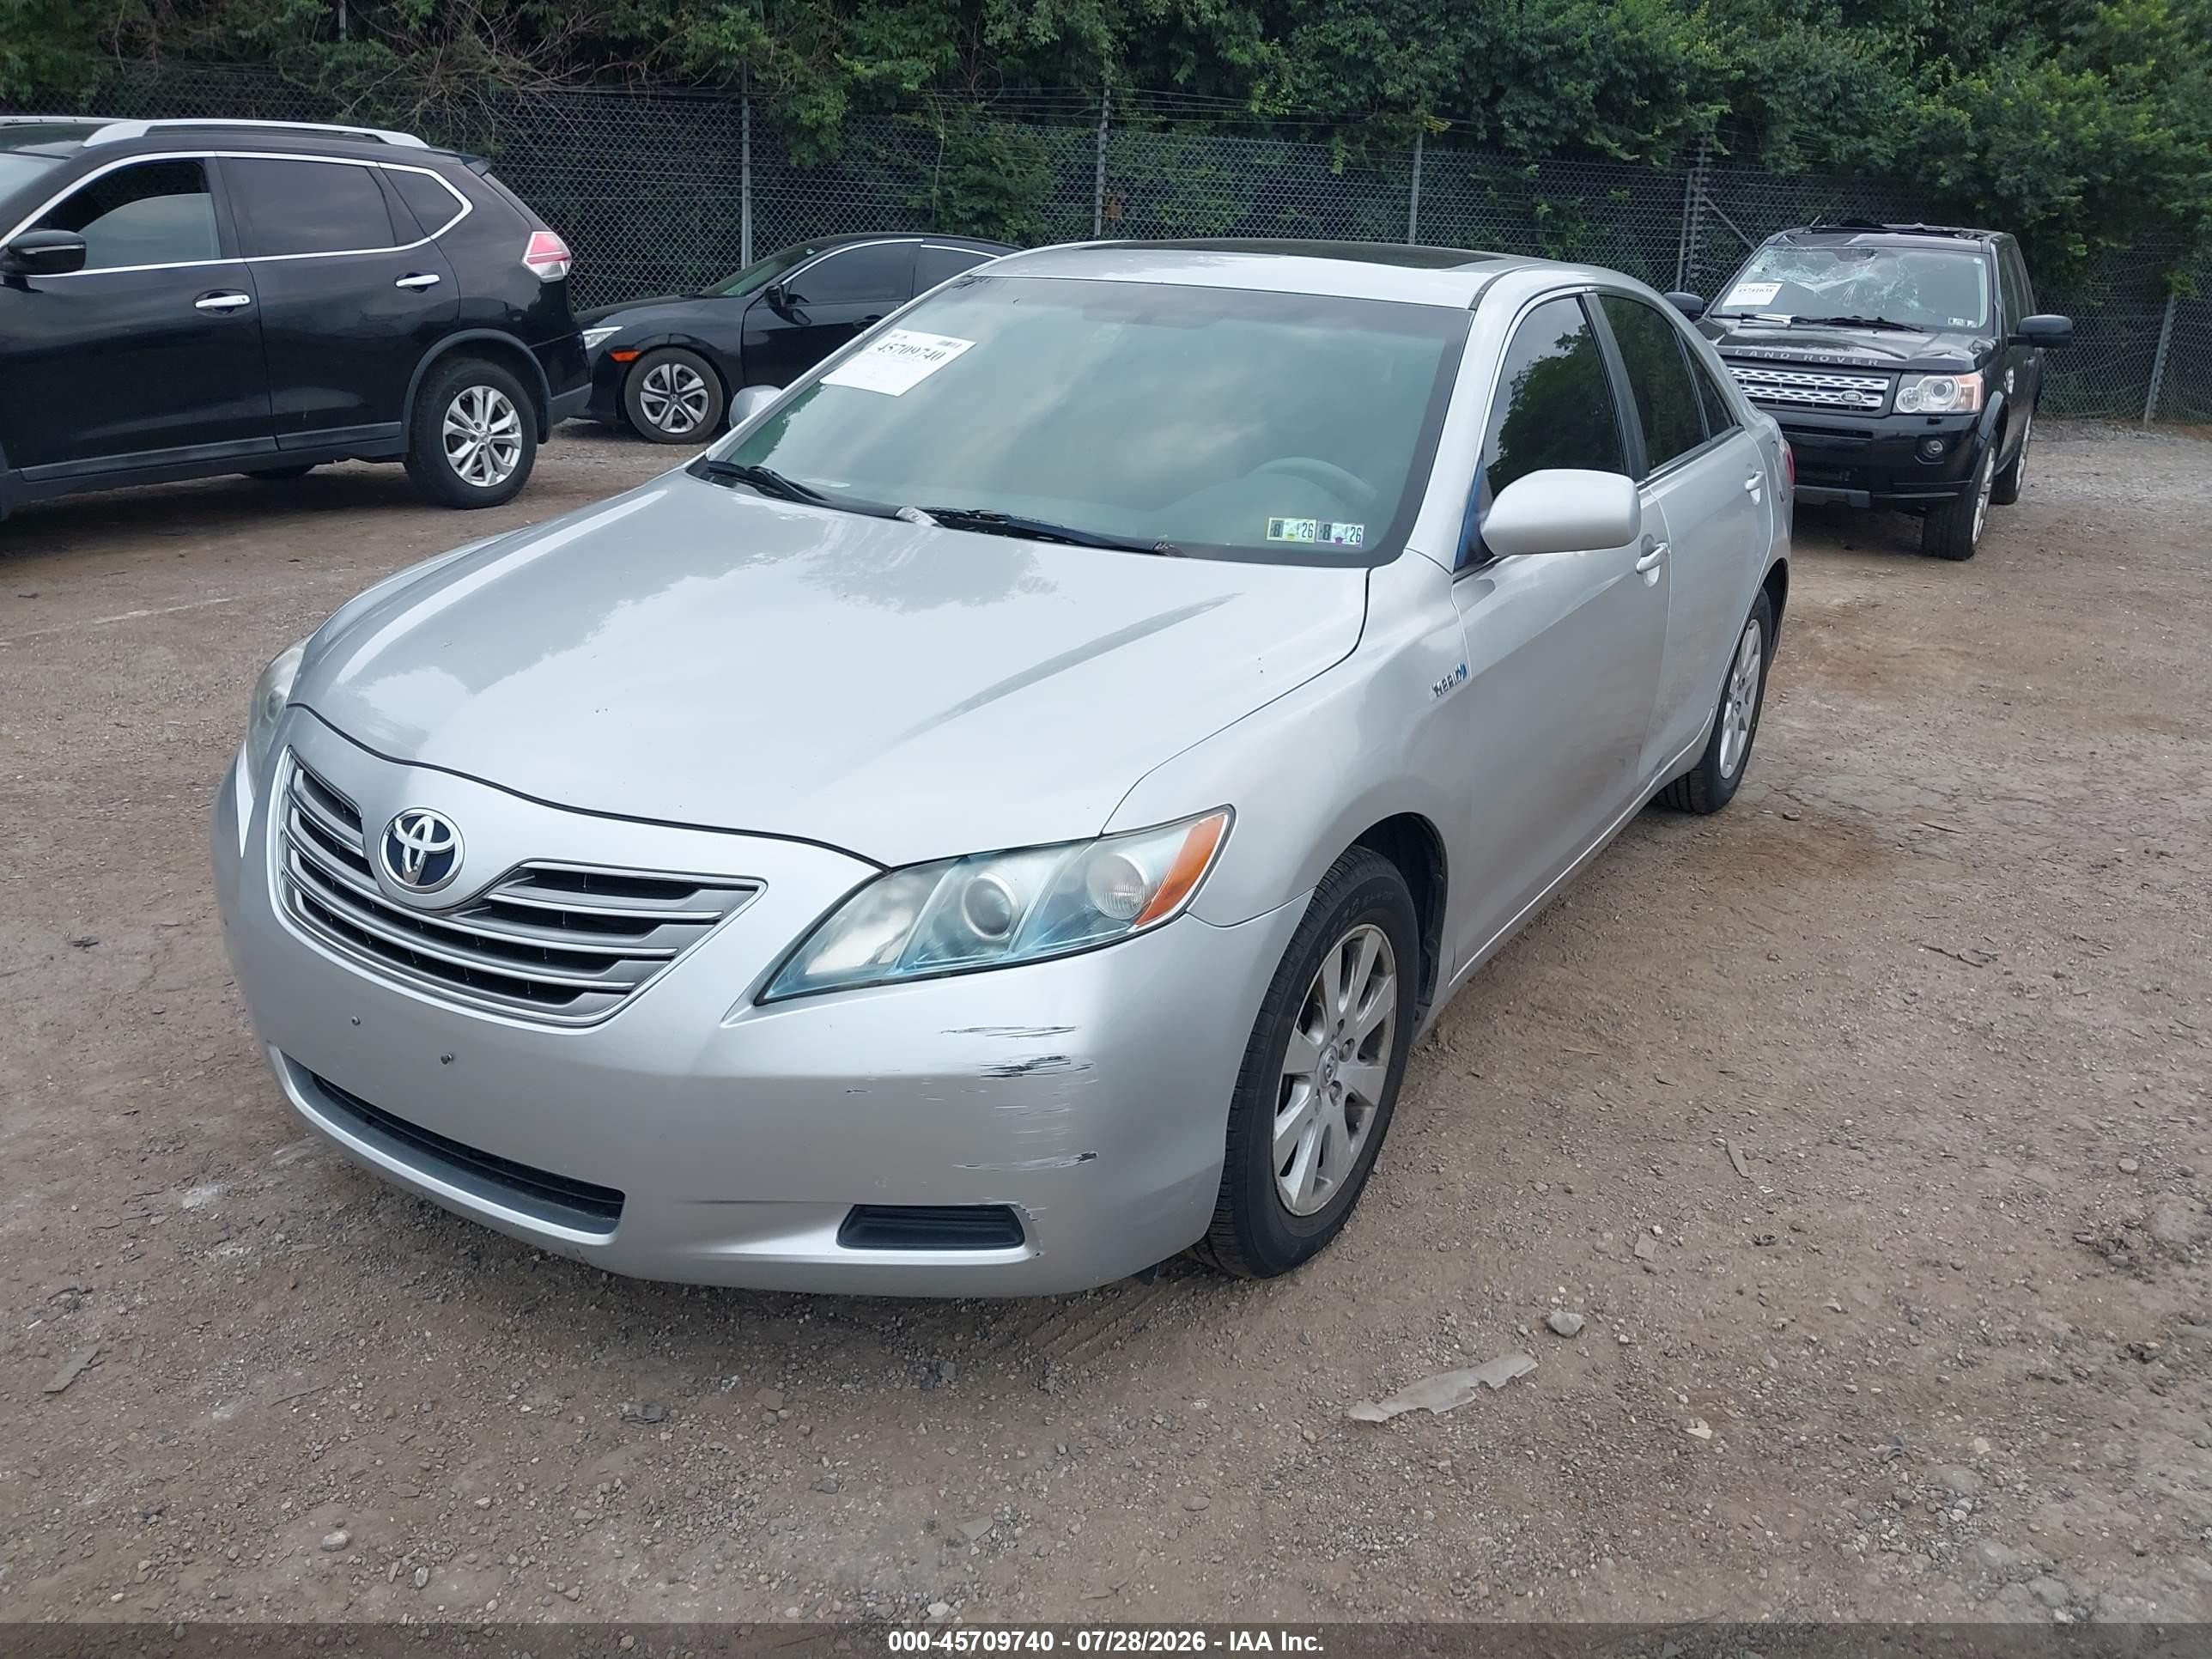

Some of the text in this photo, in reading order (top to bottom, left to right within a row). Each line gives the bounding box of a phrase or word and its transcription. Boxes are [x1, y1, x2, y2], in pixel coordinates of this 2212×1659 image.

[877, 342, 946, 362] 45709740
[1735, 349, 1879, 366] LAND ROVER
[1302, 522, 1314, 538] 26
[1350, 526, 1362, 543] 26
